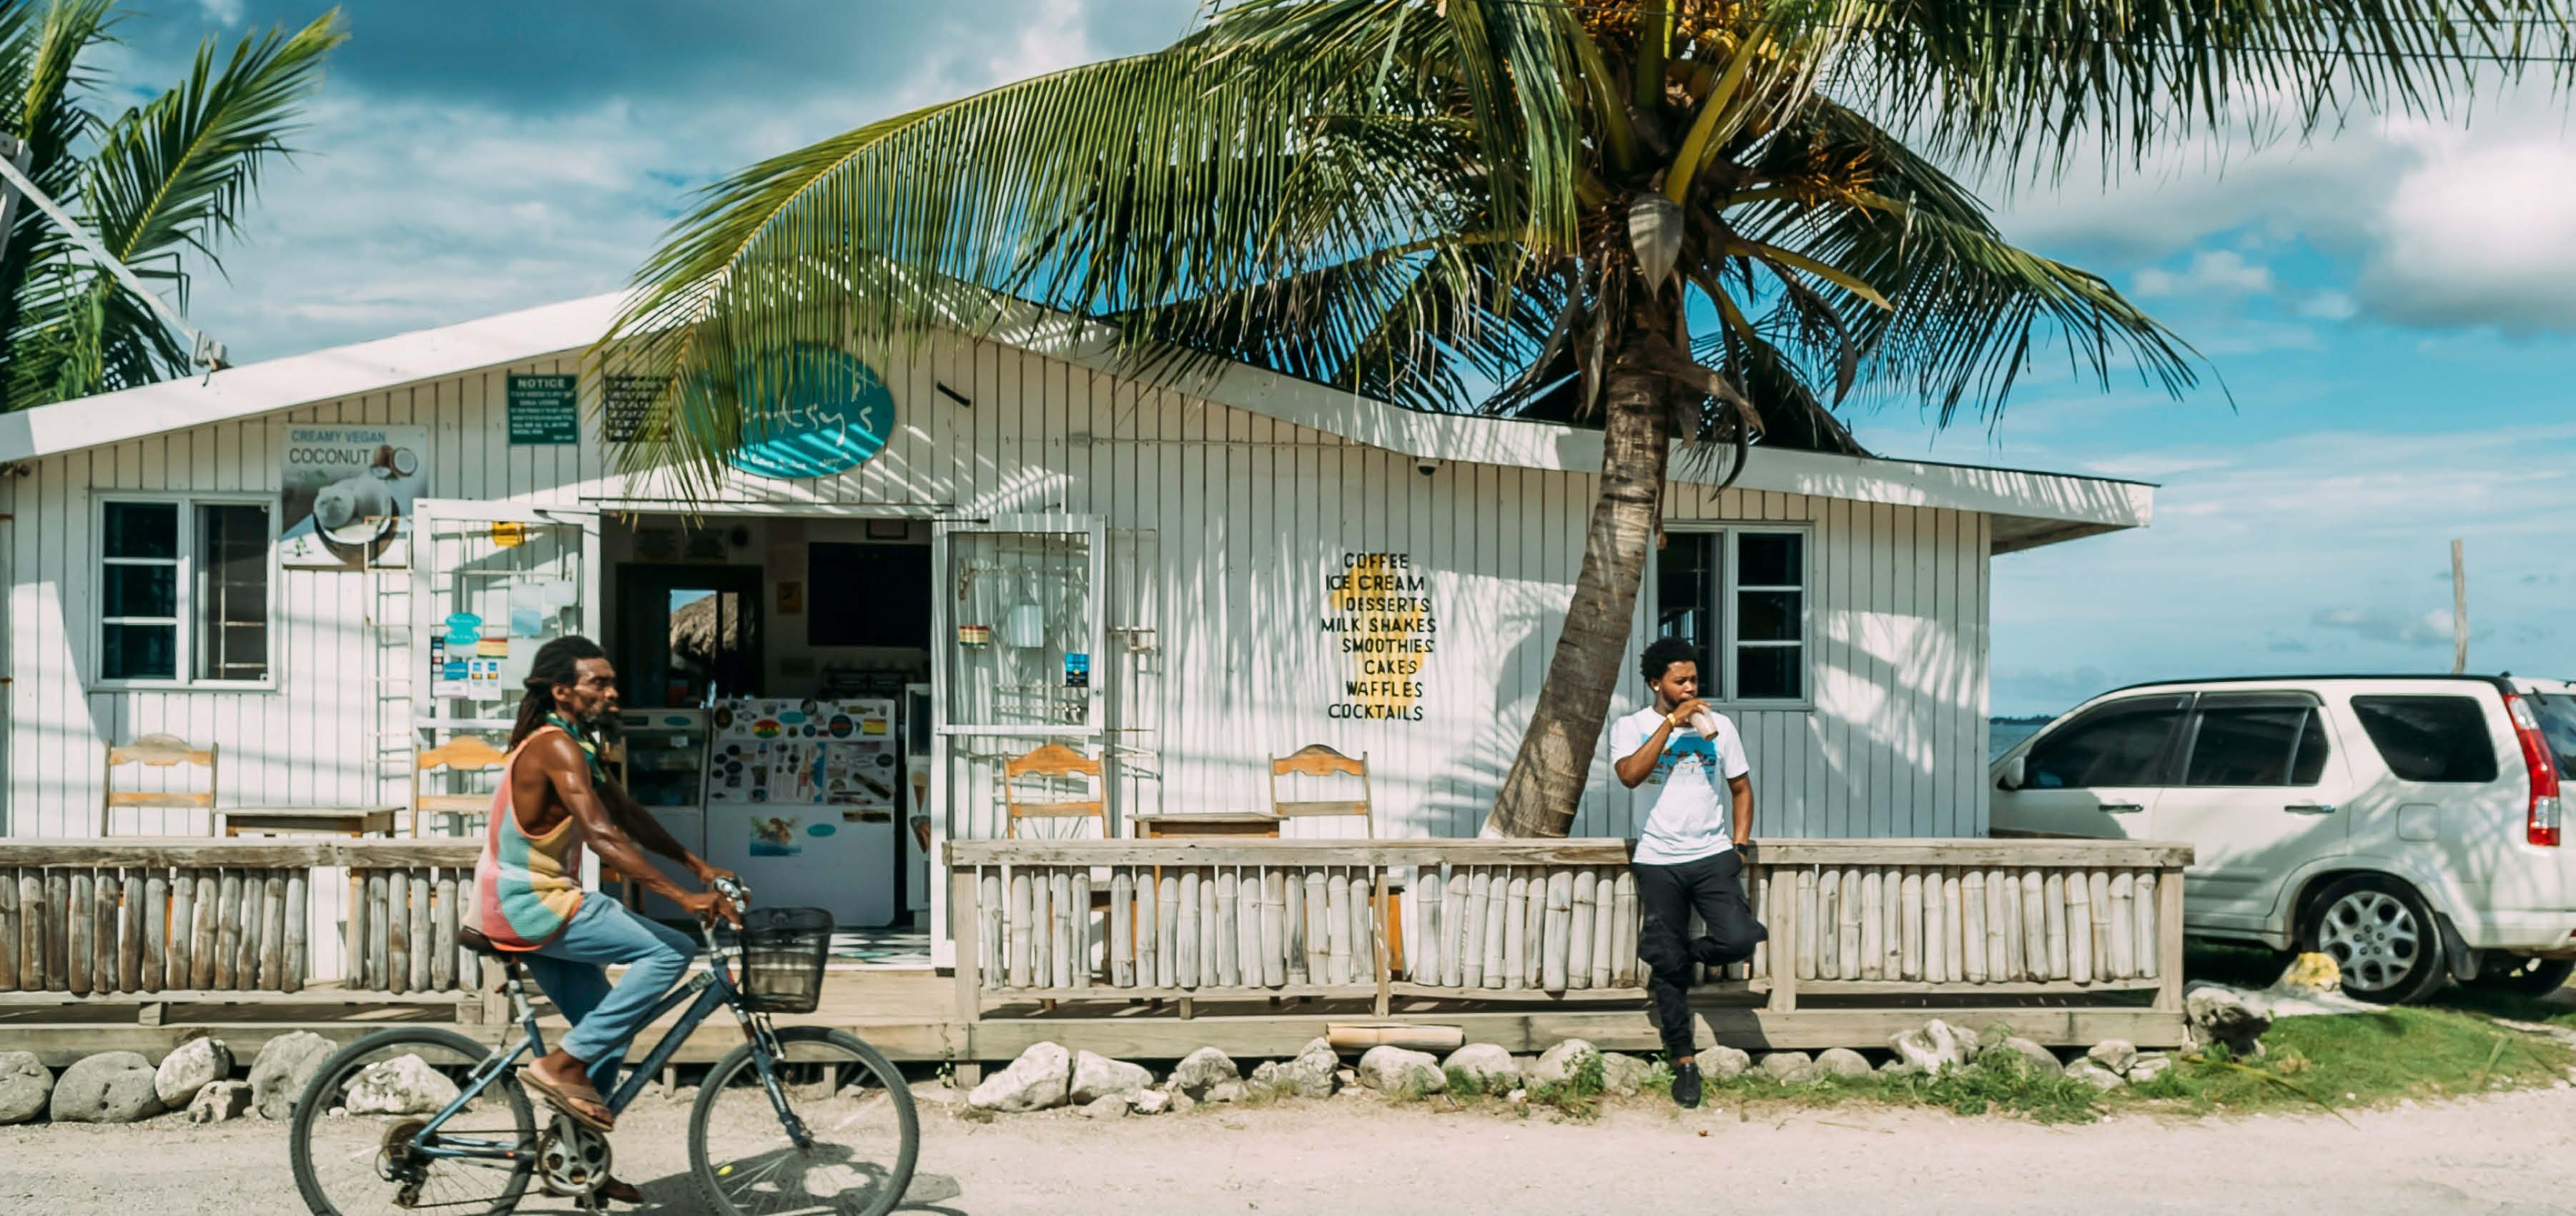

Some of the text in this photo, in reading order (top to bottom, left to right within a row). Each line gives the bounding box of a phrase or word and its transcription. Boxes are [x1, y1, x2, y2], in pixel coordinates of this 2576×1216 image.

[518, 378, 565, 388] NOTICE
[291, 430, 386, 443] CREAMY VEGAN
[289, 448, 370, 465] COCONUT
[1343, 553, 1409, 569] COFFEE
[1326, 575, 1424, 591] ICE CREAM
[1346, 597, 1430, 613] DESSERTS
[1321, 618, 1436, 633] MILK SHAKES
[1342, 638, 1435, 653] SMOOTHIES
[1364, 659, 1417, 675] CAKES
[1346, 681, 1423, 698] WAFFLES
[1328, 703, 1423, 721] COCKTAILS
